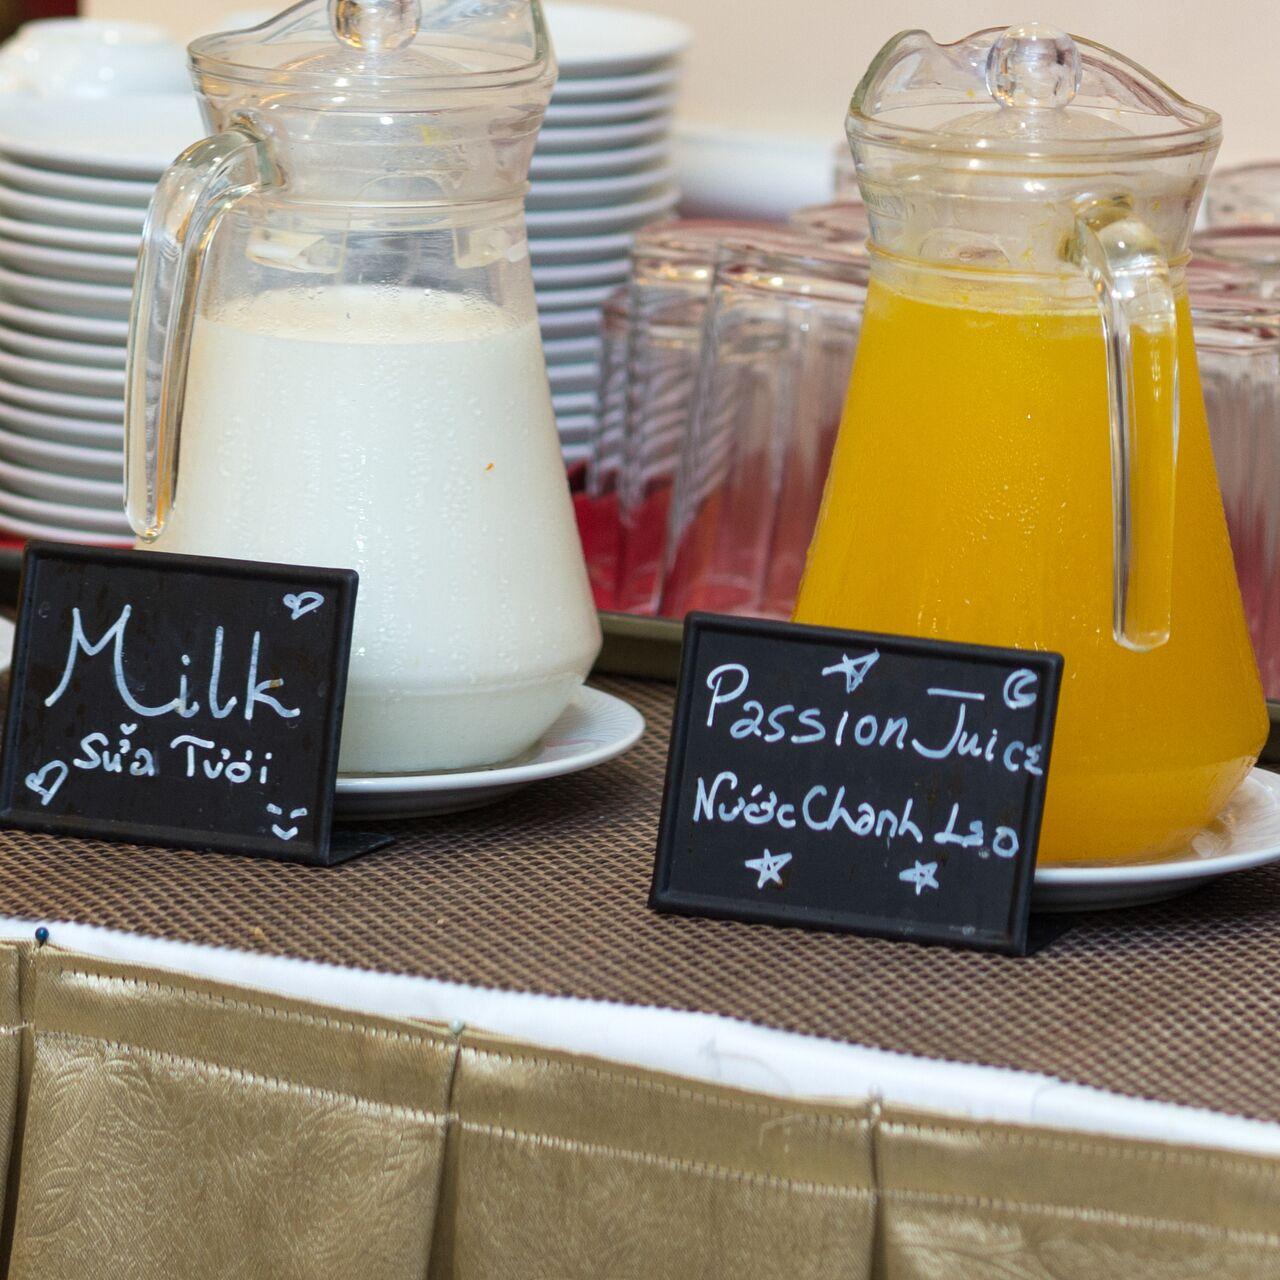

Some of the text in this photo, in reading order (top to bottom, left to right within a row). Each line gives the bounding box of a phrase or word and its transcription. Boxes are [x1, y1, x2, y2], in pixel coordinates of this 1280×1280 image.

[44, 604, 301, 721] Milk
[706, 663, 1043, 776] Passion Juice
[802, 785, 924, 844] Chanh
